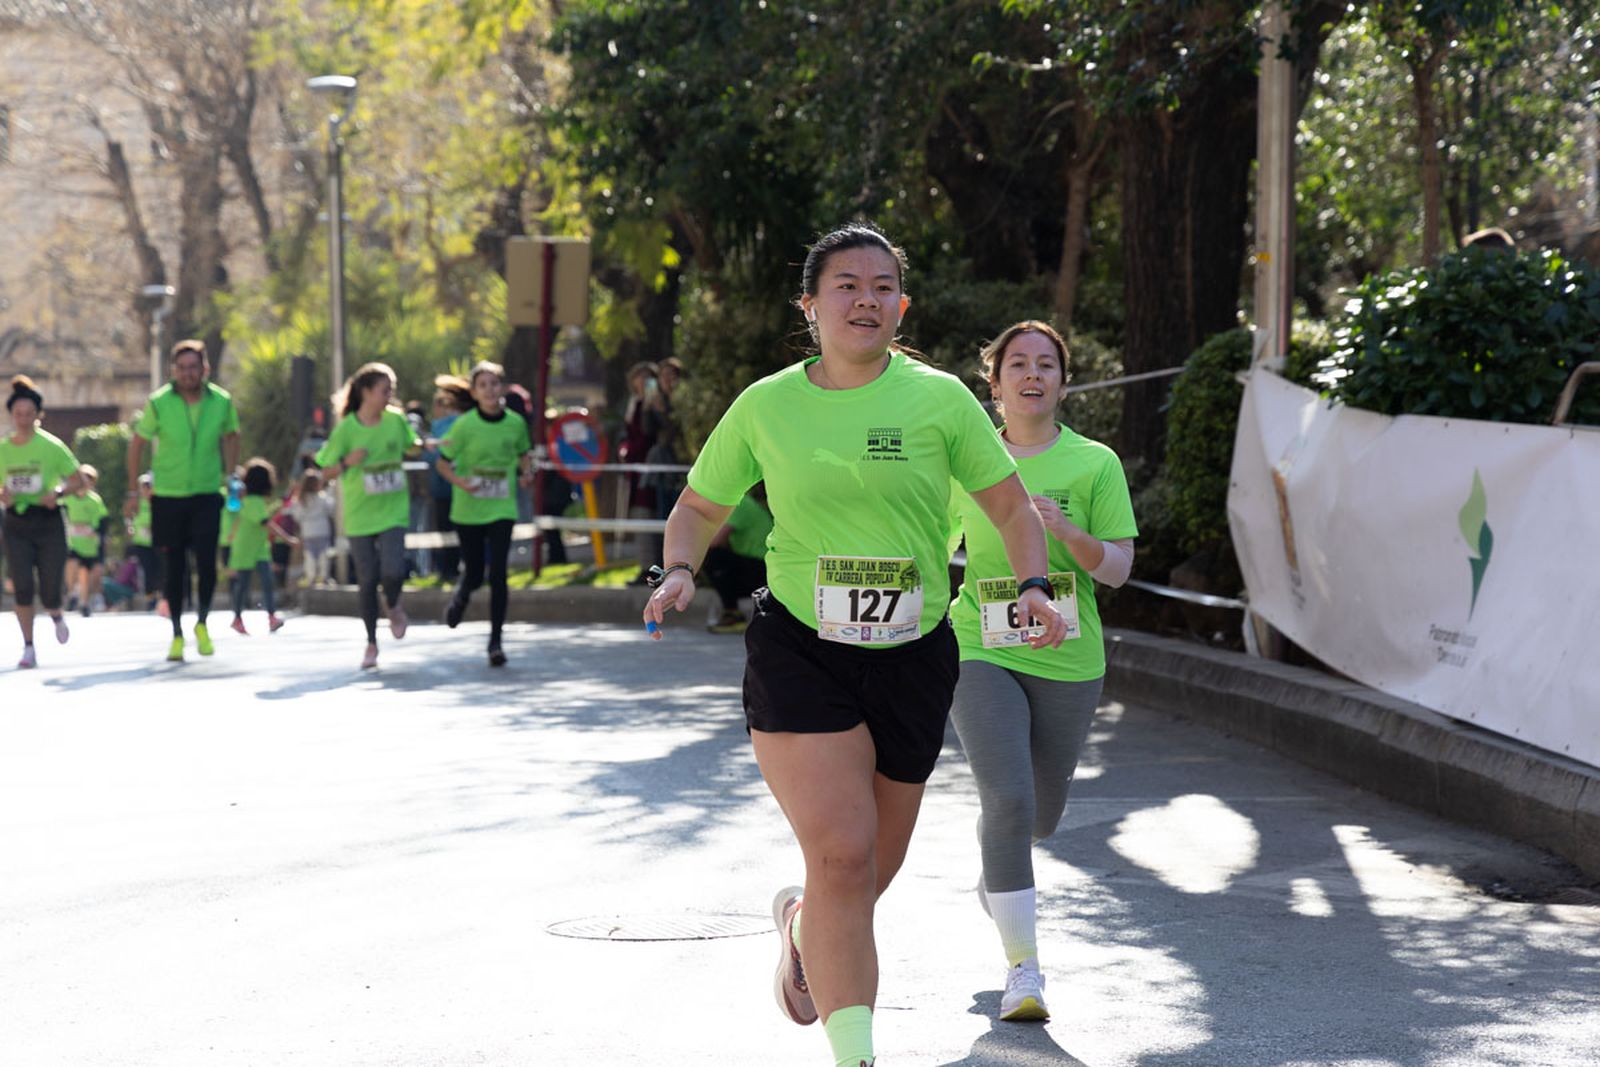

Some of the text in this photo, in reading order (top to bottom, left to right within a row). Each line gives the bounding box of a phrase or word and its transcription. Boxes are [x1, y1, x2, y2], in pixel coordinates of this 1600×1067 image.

[839, 560, 855, 571] SAN
[856, 560, 877, 572] JUAN
[878, 561, 901, 573] BOSCO
[834, 572, 864, 585] CARRERA
[865, 573, 895, 585] POPULAR
[995, 581, 1008, 590] SAN
[848, 588, 902, 623] 127
